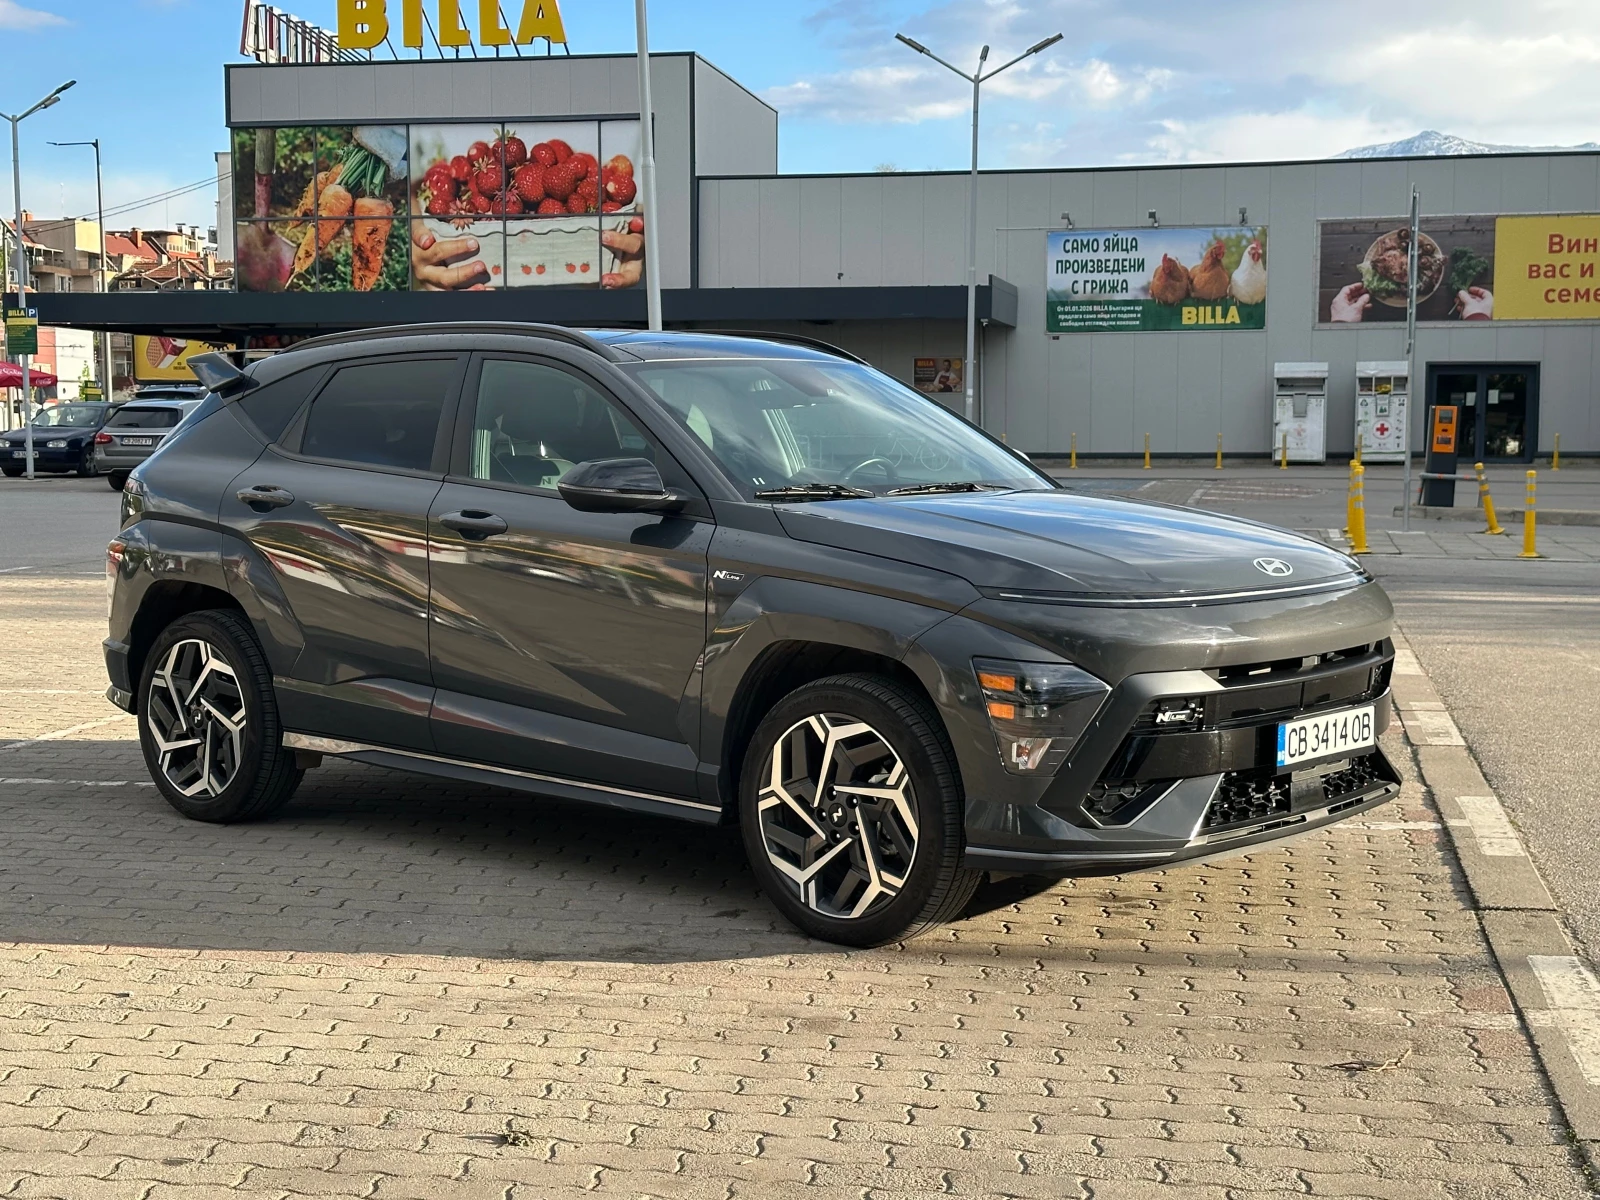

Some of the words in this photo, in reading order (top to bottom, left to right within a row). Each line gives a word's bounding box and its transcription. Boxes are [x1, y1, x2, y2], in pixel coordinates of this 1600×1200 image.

[338, 0, 567, 49] BILLA
[1063, 238, 1099, 253] САМО
[1103, 233, 1138, 254] ЯЙЦА
[1548, 233, 1598, 254] Вин
[1055, 258, 1145, 275] ПРОИЗВЕДЕНИ
[1528, 262, 1571, 279] вас
[1580, 263, 1594, 278] и
[1071, 280, 1079, 294] С
[1083, 279, 1129, 294] ГРИЖА
[1182, 306, 1240, 324] BILLA
[1288, 726, 1307, 758] CB
[1311, 716, 1347, 752] 3414
